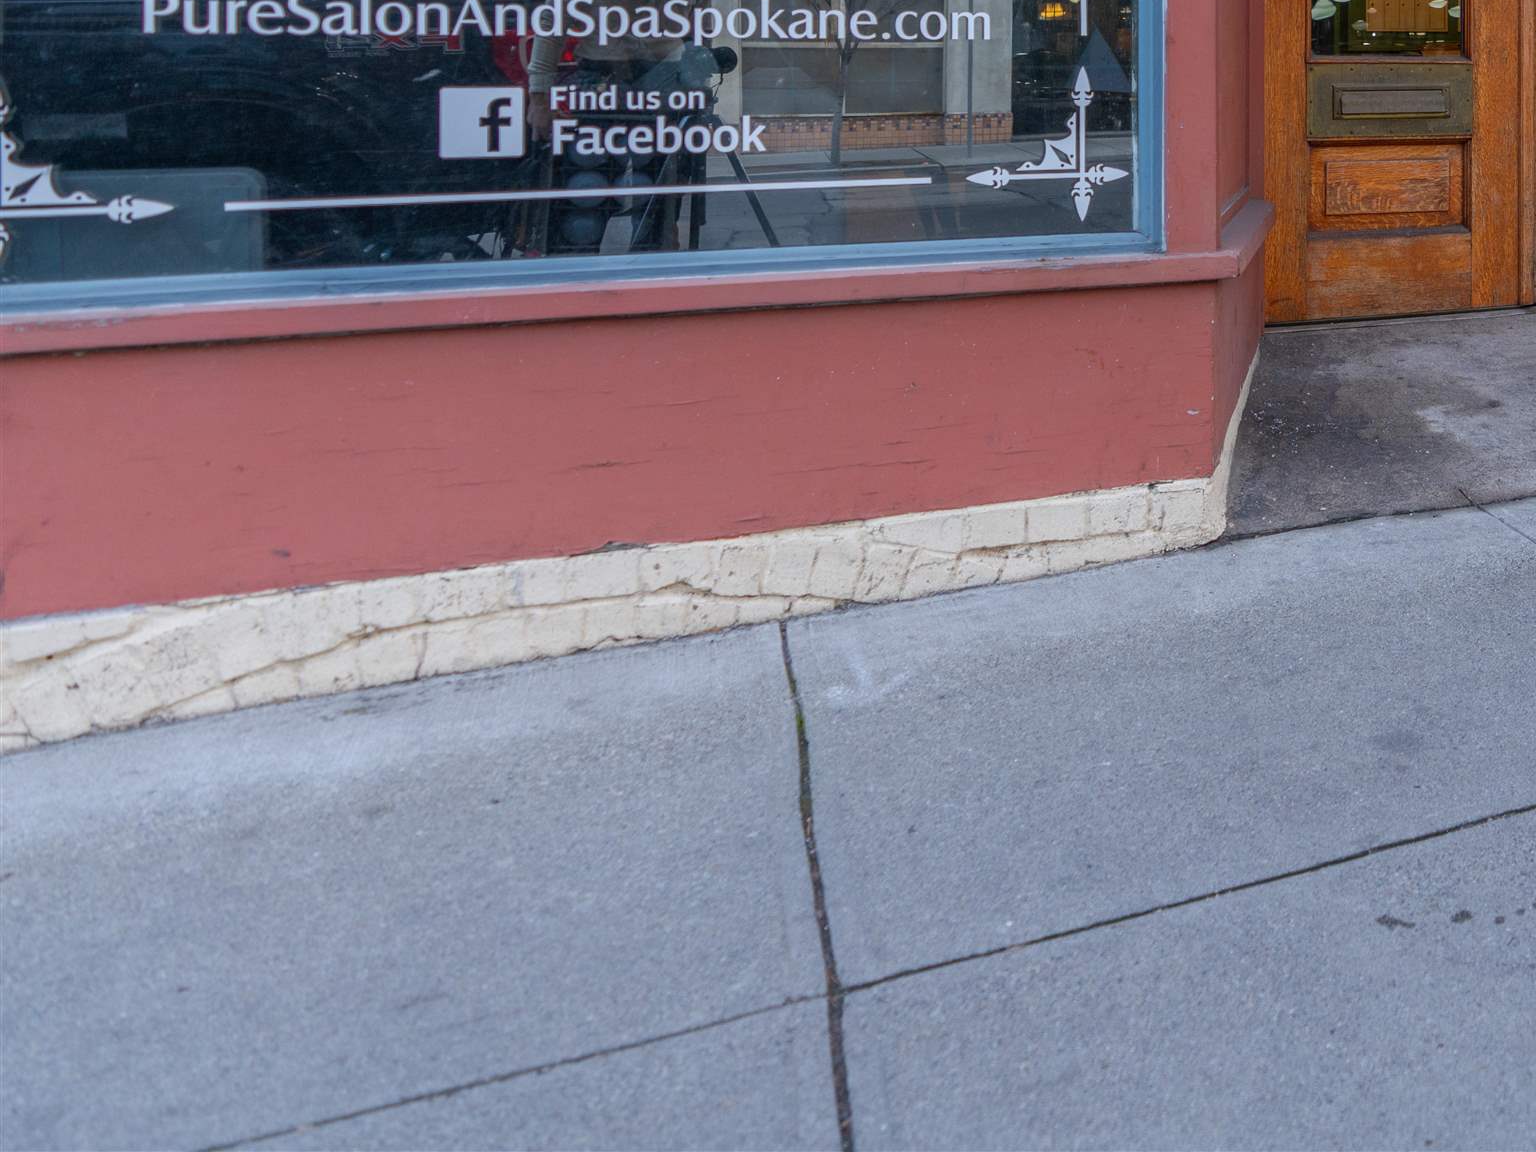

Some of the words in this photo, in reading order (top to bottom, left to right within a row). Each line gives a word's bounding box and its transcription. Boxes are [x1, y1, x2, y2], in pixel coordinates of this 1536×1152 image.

[551, 85, 616, 111] Find
[627, 91, 660, 110] us
[669, 91, 705, 110] on
[552, 114, 767, 156] Facebook
